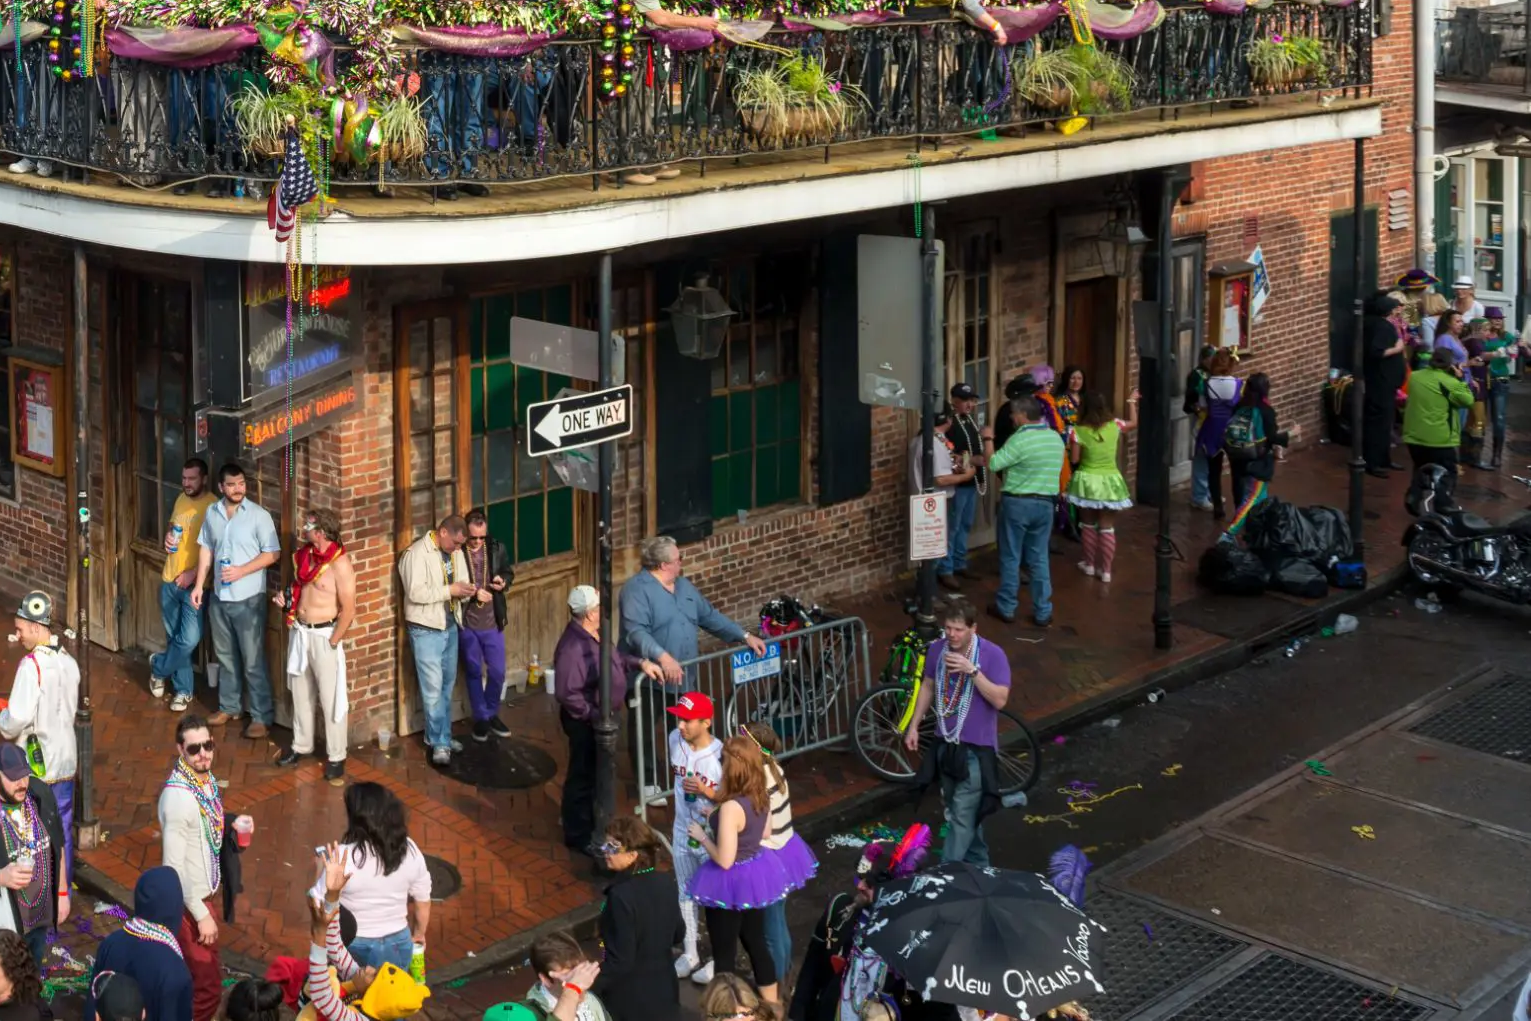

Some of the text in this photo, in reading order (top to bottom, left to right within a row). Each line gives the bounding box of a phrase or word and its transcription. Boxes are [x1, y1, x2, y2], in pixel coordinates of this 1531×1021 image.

[253, 386, 356, 446] BALCONY DINING
[562, 402, 622, 433] ONE WAY
